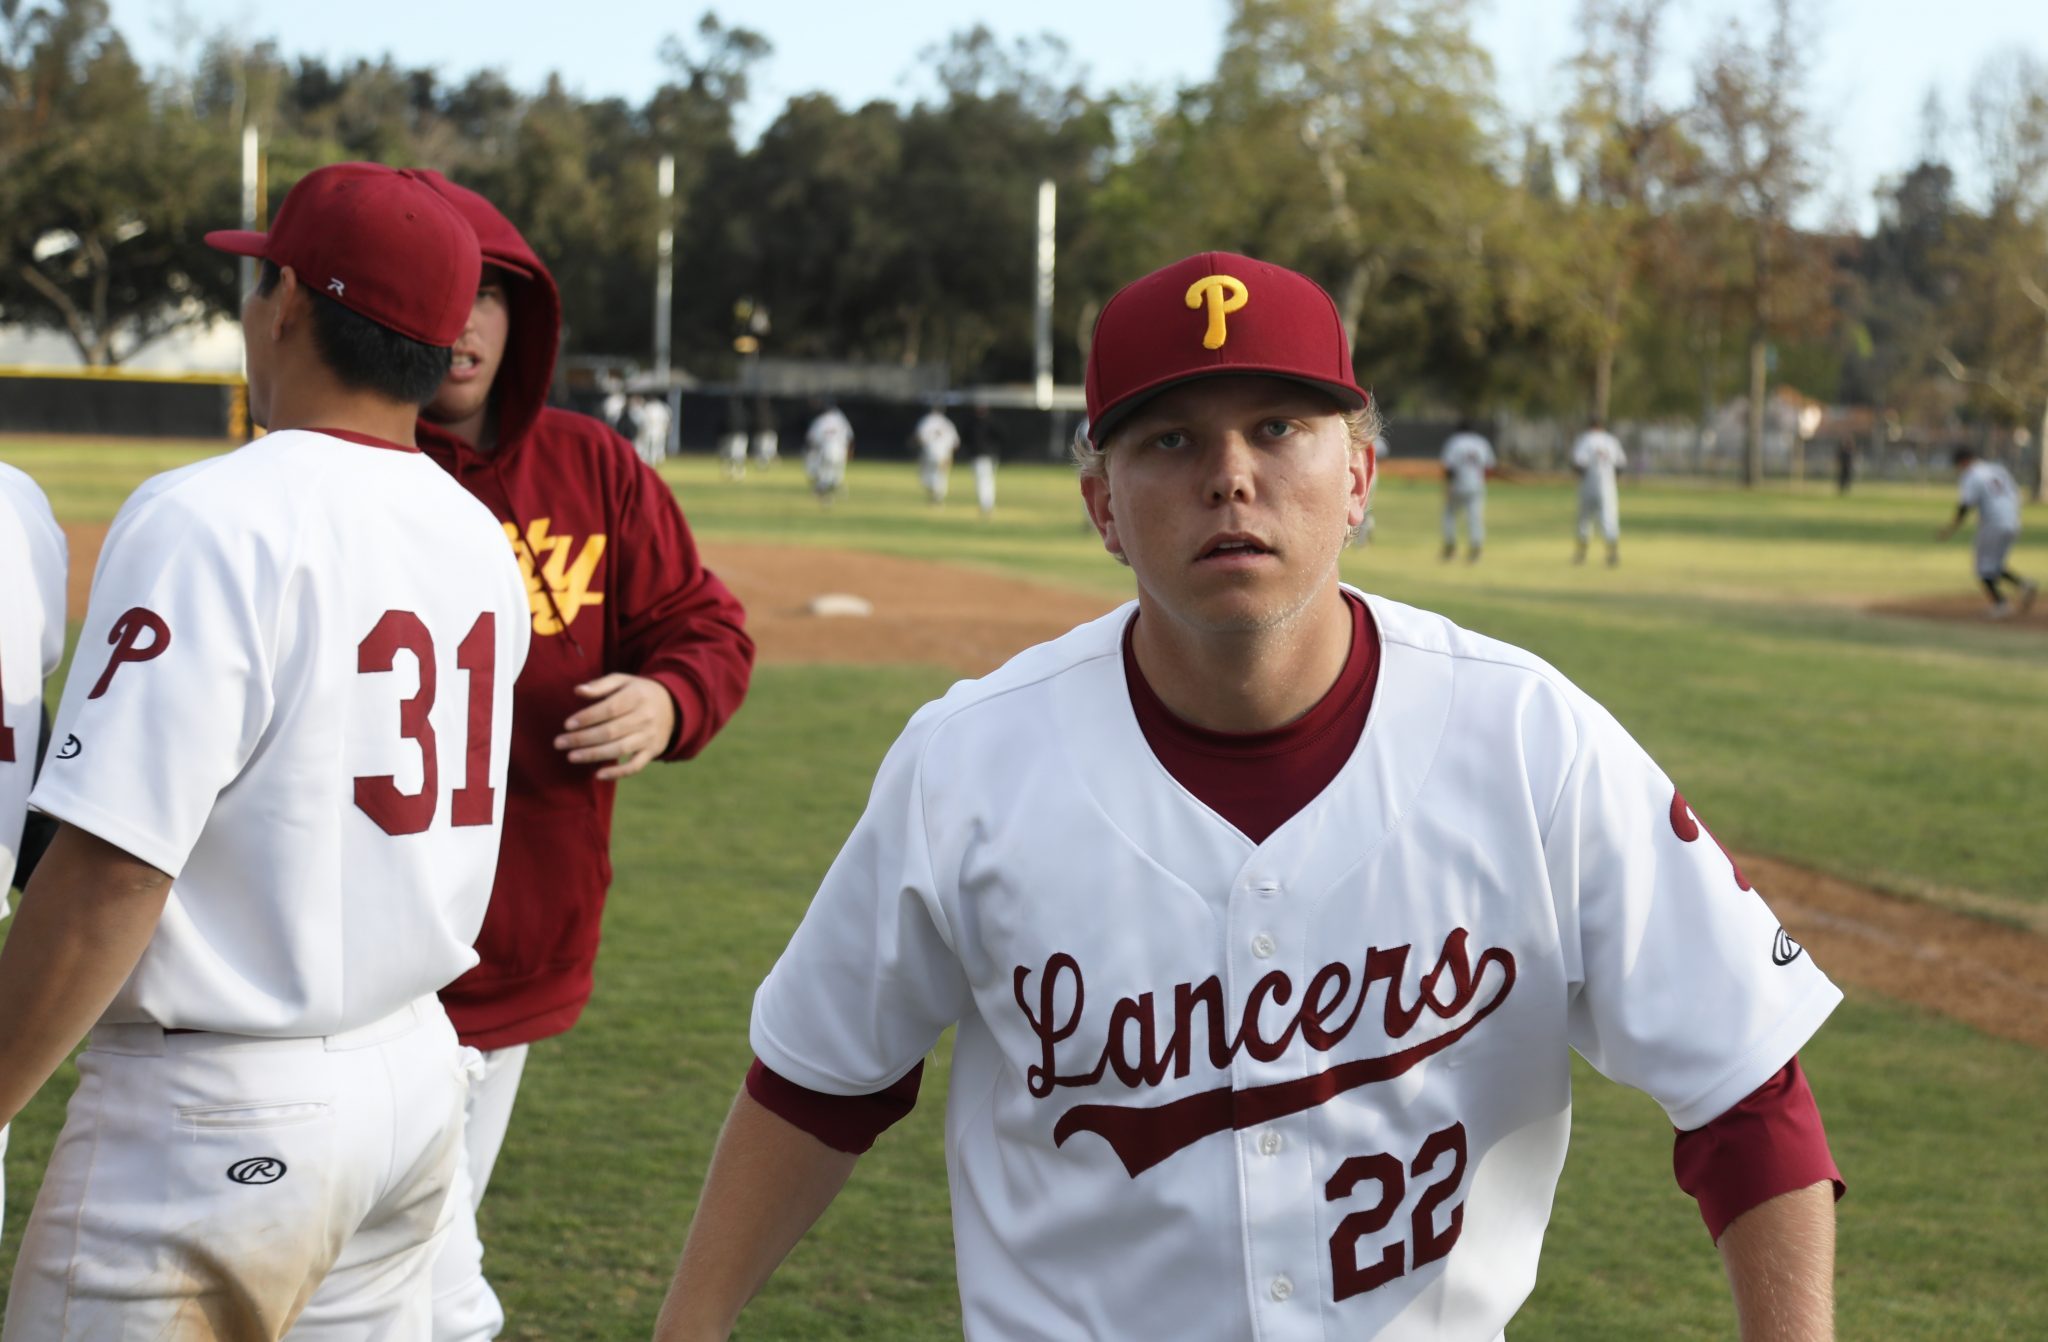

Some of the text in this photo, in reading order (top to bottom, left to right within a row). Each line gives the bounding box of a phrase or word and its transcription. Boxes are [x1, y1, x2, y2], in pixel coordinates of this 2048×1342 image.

[1185, 274, 1249, 350] P
[87, 606, 171, 700] P
[354, 609, 496, 836] 31
[1013, 927, 1516, 1099] Lancers
[1325, 1120, 1467, 1302] 22
